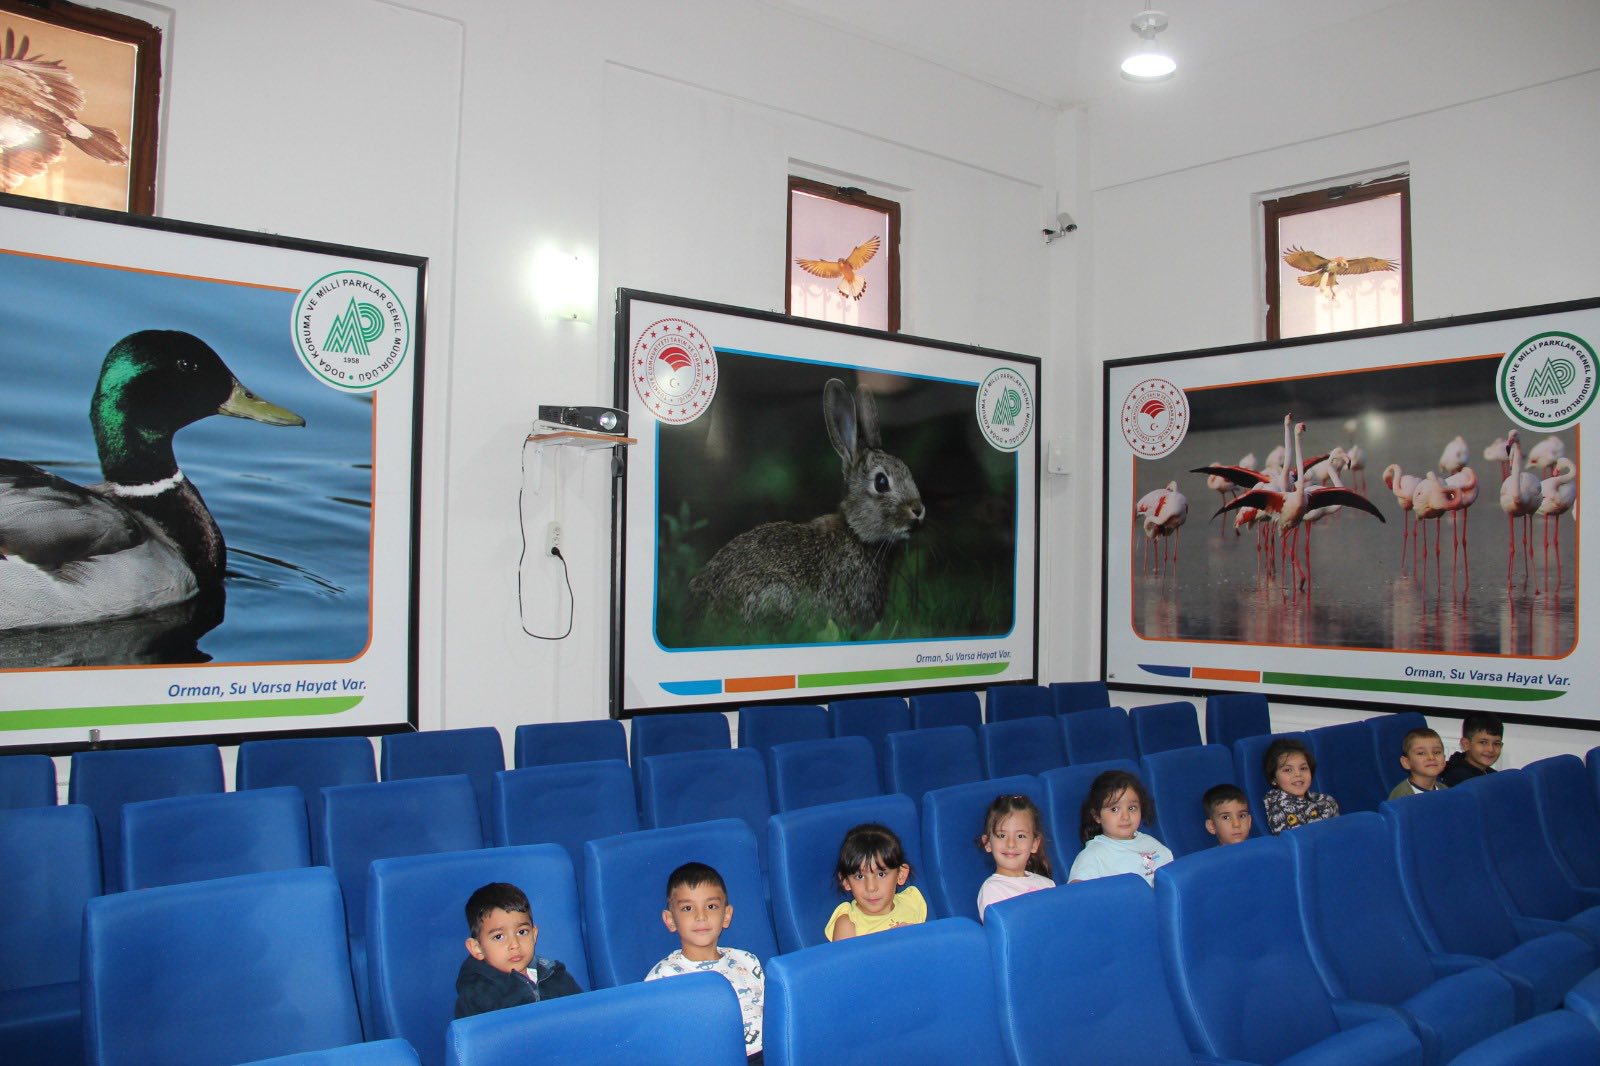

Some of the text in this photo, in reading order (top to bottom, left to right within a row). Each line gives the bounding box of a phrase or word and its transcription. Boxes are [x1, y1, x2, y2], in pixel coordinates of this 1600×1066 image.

[316, 279, 340, 299] MİLLİ
[342, 279, 387, 301] PARKLAR
[306, 298, 318, 311] VE
[386, 301, 402, 334] GENEL
[303, 314, 320, 359] KORUMA
[1538, 340, 1577, 352] PARKLAR
[344, 356, 360, 364] 1958
[1518, 344, 1538, 362] MİLLİ
[1576, 350, 1591, 375] GENEL
[319, 358, 345, 379] DOĞA
[1512, 362, 1520, 373] VE
[1509, 375, 1524, 408] KORUMA
[916, 650, 1011, 664] Orman, Su Varsa Hayat Var.
[1404, 666, 1571, 686] Orman, Su Varsa Hayat Var.
[168, 678, 367, 698] Orman, Su Varsa Hayat Var.
